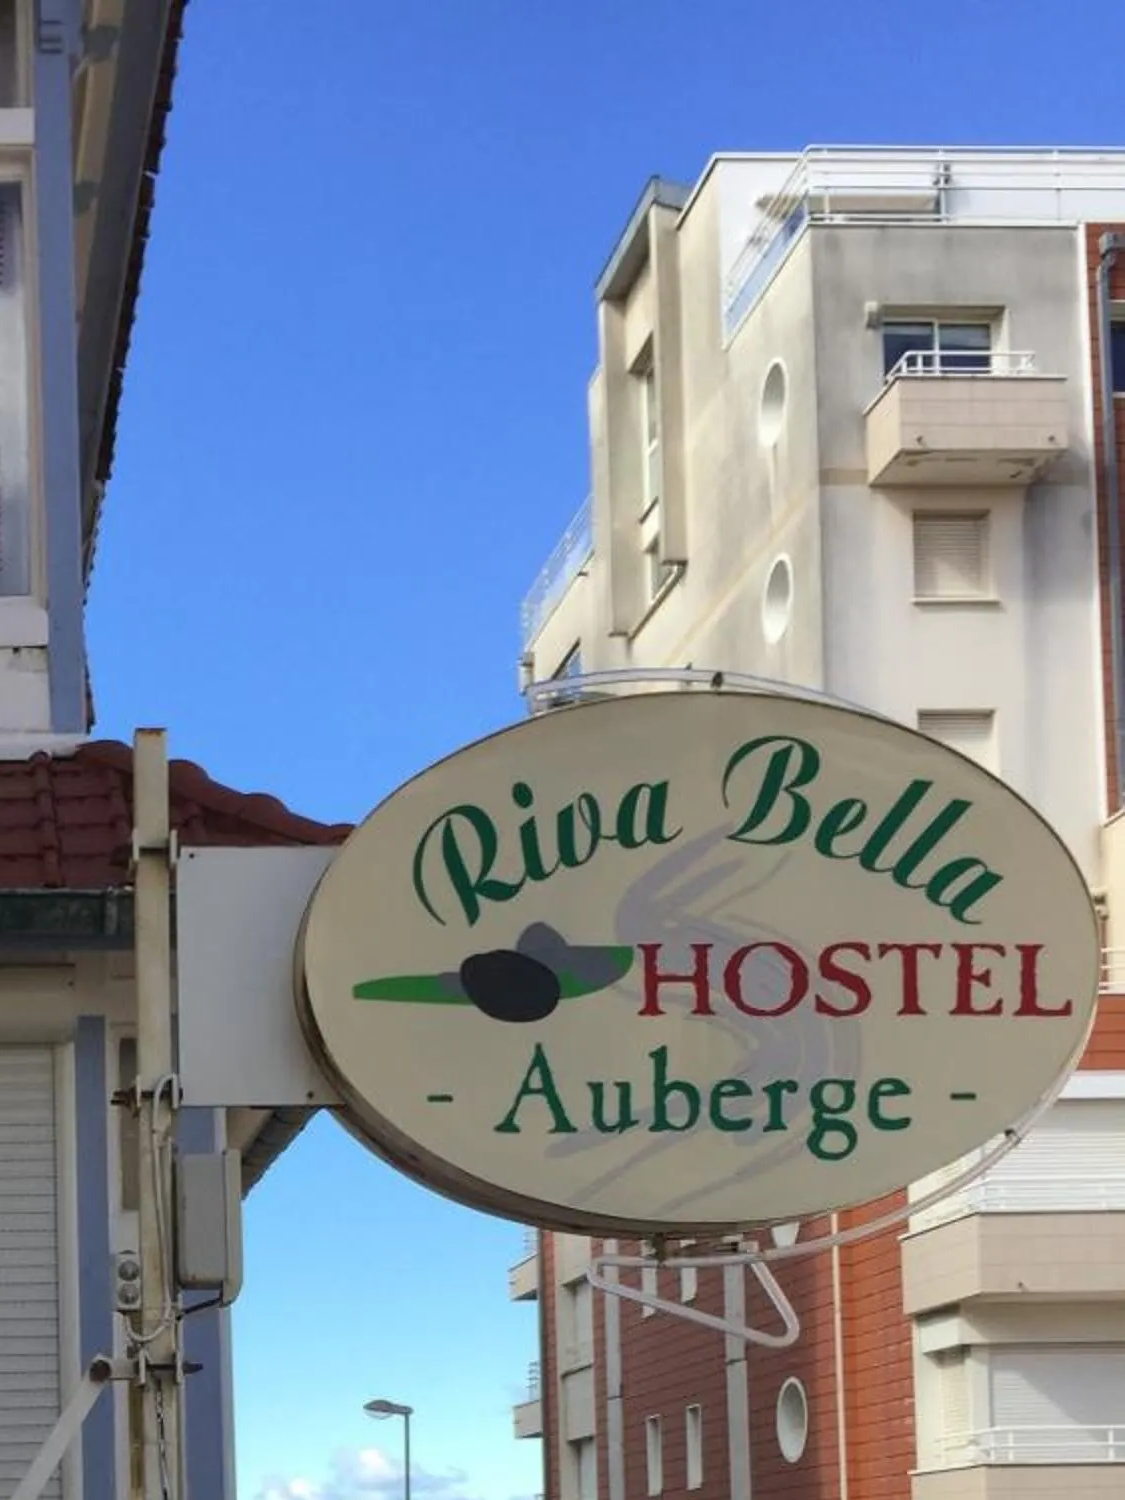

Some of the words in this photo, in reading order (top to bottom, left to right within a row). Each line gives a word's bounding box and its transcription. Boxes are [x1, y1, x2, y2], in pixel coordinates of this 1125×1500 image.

[413, 781, 682, 927] Riva
[721, 735, 1005, 924] Bella
[635, 942, 1073, 1018] HOSTEL
[494, 1044, 912, 1161] Auberge
